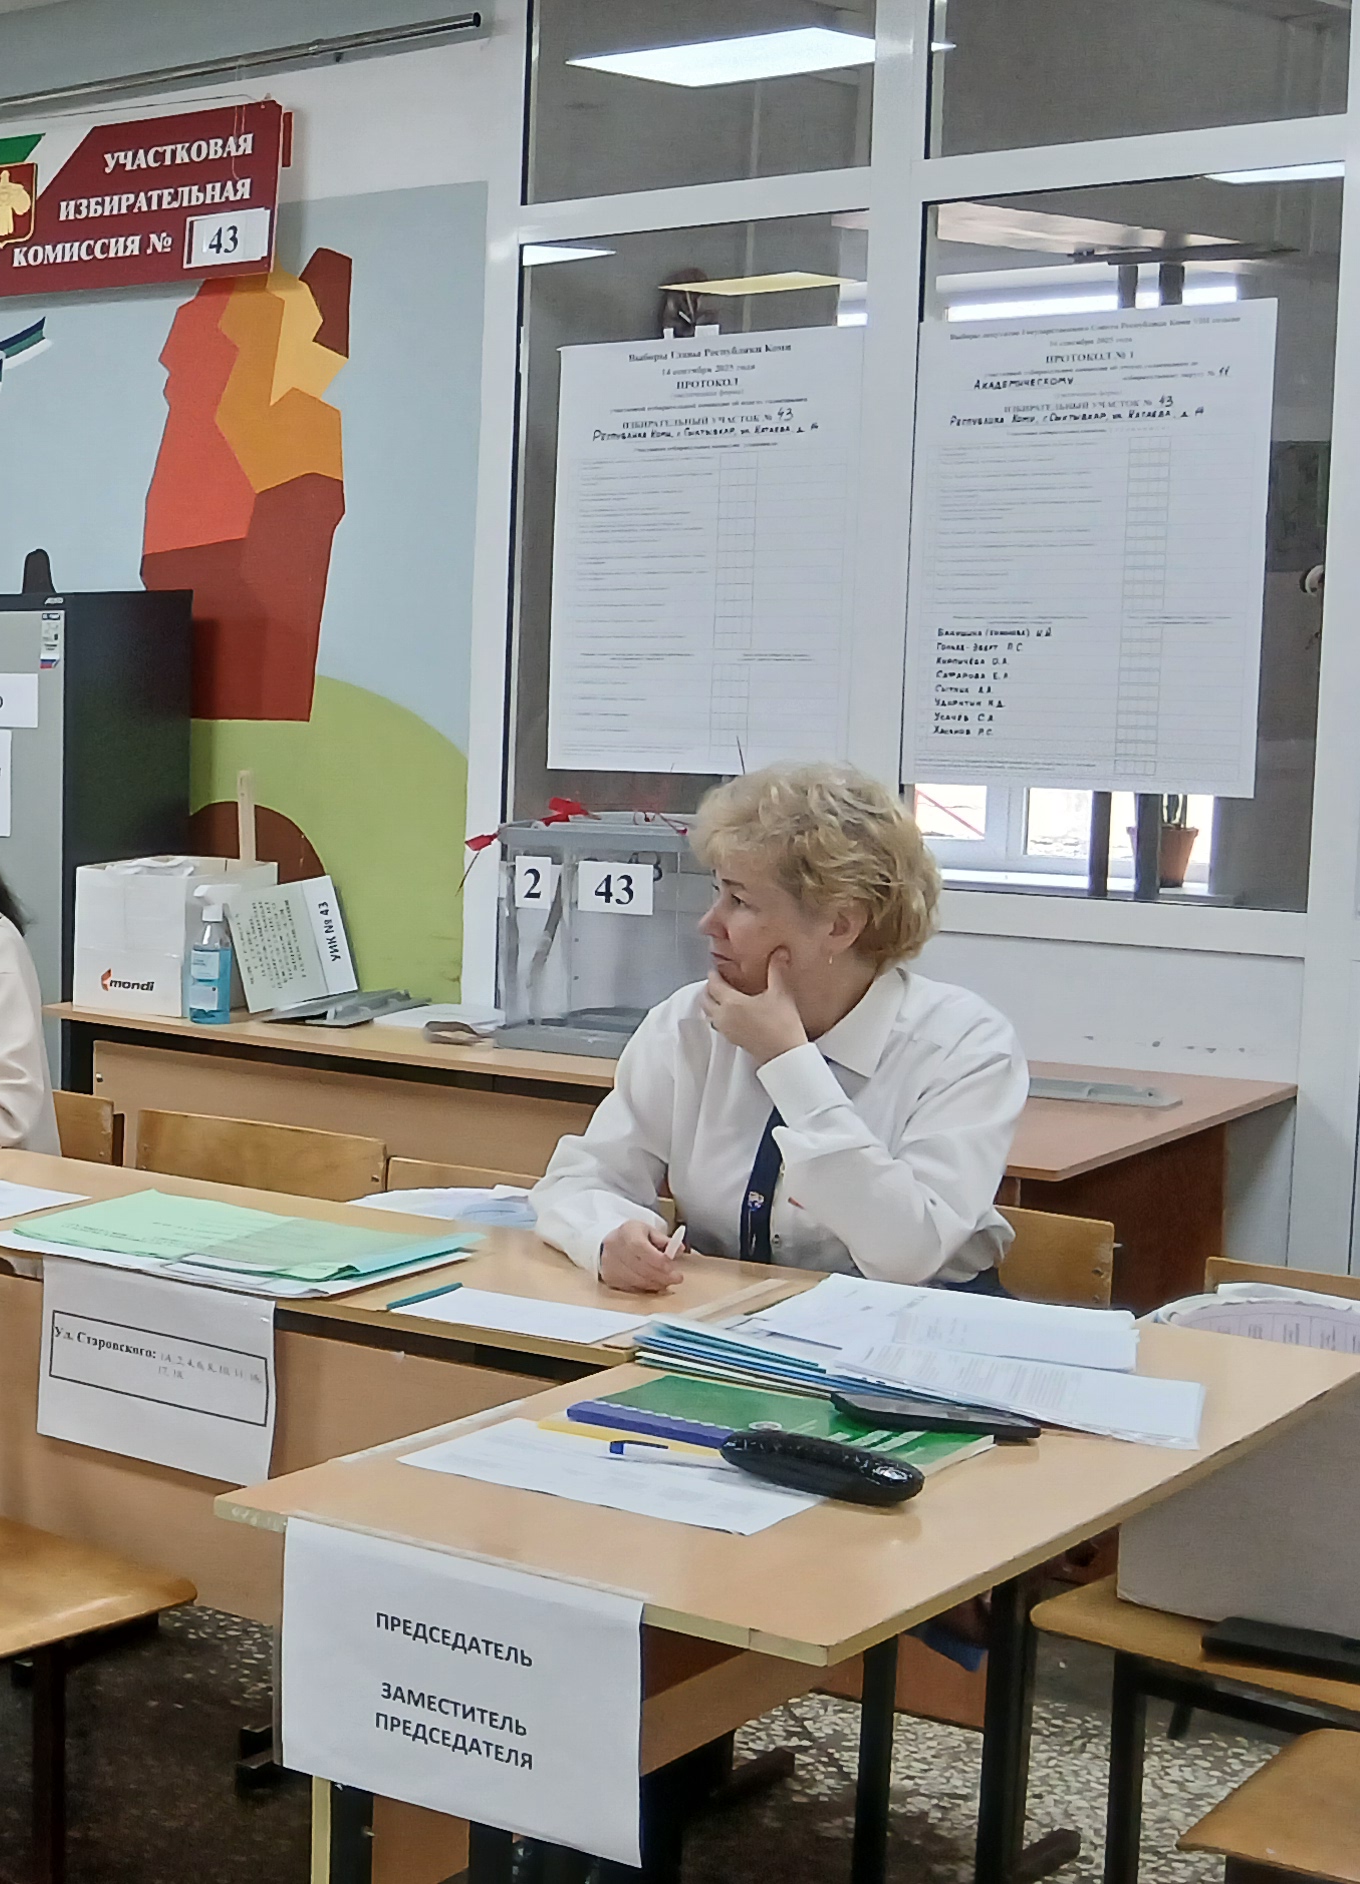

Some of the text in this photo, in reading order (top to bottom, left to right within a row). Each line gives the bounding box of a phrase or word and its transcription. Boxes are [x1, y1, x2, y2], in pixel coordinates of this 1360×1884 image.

[104, 133, 253, 173] УЧАСТКОВАЯ
[58, 178, 251, 221] ИЗБИРАТЕЛЬНАЯ
[12, 225, 238, 268] КОМИССИЯ № 43
[523, 868, 542, 899] 2
[594, 874, 634, 906] 43
[318, 902, 329, 916] 43
[110, 979, 154, 992] mondi
[77, 1331, 157, 1359] Старовского:
[375, 1612, 534, 1668] ПРЕДСЕДАТЕЛЬ
[381, 1682, 528, 1737] ЗАМЕСТИТЕЛЬ
[375, 1712, 534, 1771] ПРЕДСЕДАТЕЛЯ
